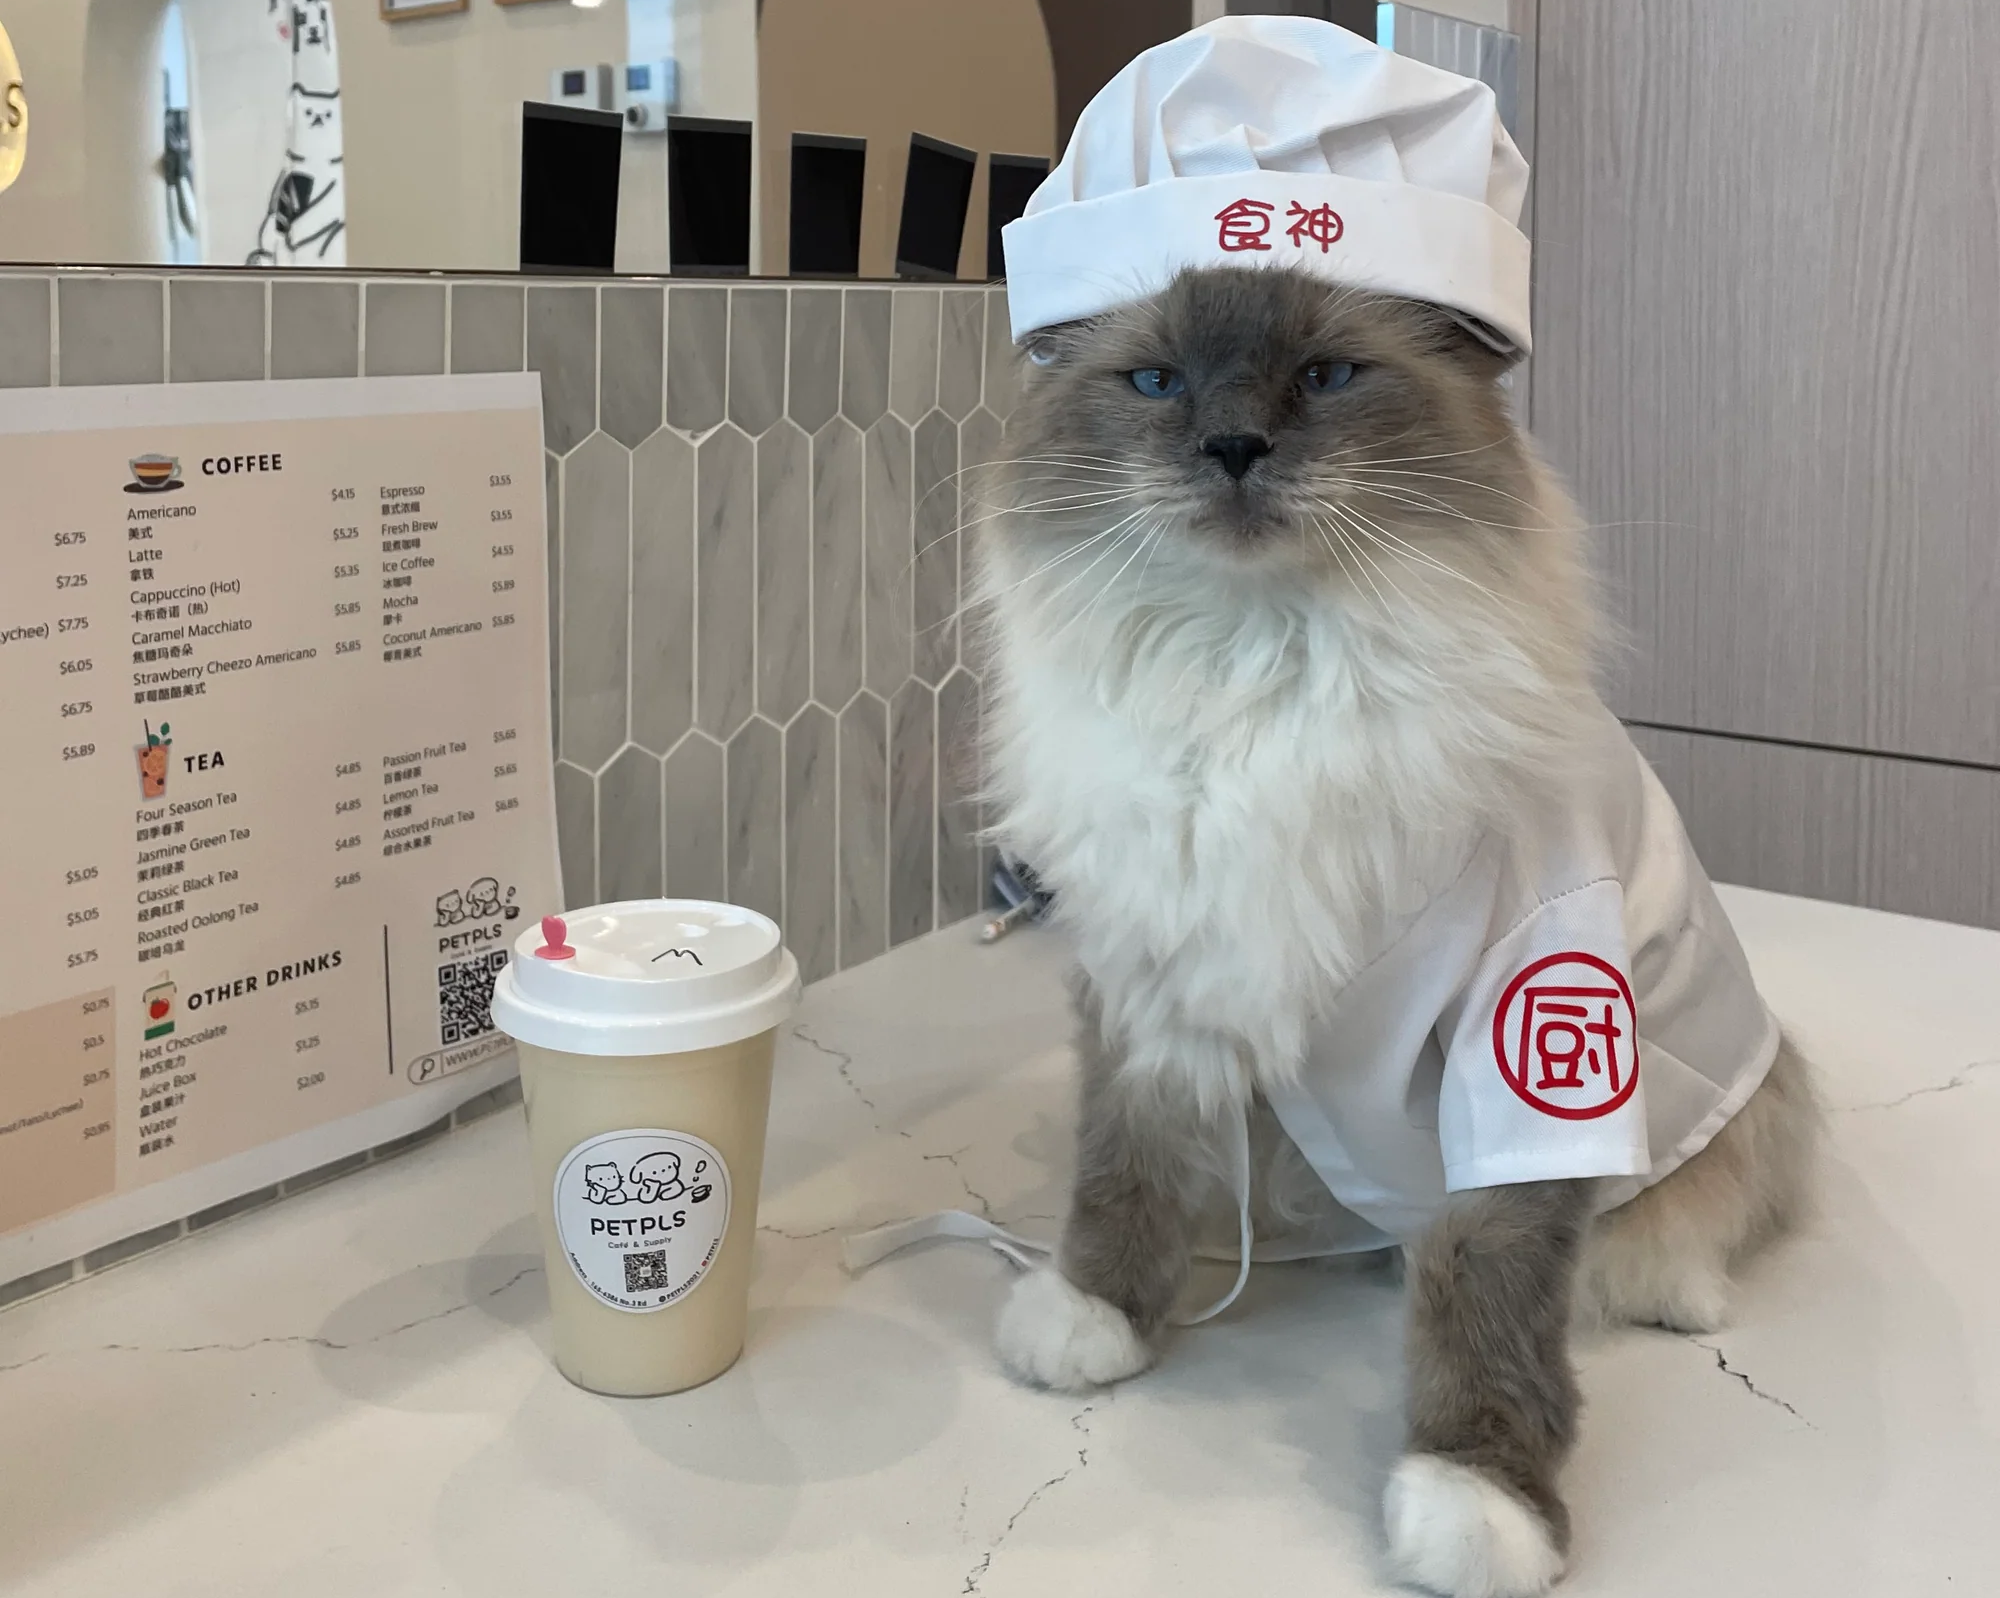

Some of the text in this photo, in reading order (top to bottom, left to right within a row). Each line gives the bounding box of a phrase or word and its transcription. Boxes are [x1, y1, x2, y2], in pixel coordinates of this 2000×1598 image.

[1214, 198, 1344, 253] 食神
[202, 454, 282, 475] COFFEE
[380, 475, 511, 500] Espresso $3.55
[127, 504, 196, 520] Americano
[381, 509, 512, 536] Fresh Brew $3.55
[54, 531, 86, 546] $6.75
[128, 526, 153, 540] 美式
[129, 549, 163, 563] Latte
[382, 560, 398, 572] Ice
[400, 556, 435, 571] Coffee
[56, 574, 88, 589] $7.25
[130, 568, 154, 582] 拿铁
[130, 583, 206, 605] Cappuccino
[210, 579, 241, 597] (Hot)
[383, 595, 419, 609] Mocha
[58, 617, 89, 632] $7.75
[132, 626, 184, 645] Caramel
[188, 618, 252, 637] Macchiato
[383, 629, 426, 645] Coconut
[430, 621, 482, 637] Americano
[133, 644, 193, 664] 焦糖玛奇朵
[60, 659, 93, 675] $6.05
[133, 666, 203, 686] Strawberry
[207, 657, 252, 675] Cheezo
[255, 647, 317, 667] Americano
[61, 702, 92, 718] $6.75
[62, 744, 95, 761] $5.89
[184, 751, 224, 773] TEA
[383, 752, 421, 768] Passion
[423, 744, 446, 759] Fruit
[449, 742, 466, 753] Tea
[383, 788, 418, 805] Lemon
[421, 783, 439, 795] Tea
[136, 807, 165, 823] Four
[169, 798, 213, 816] Season
[217, 792, 237, 805] Tea
[383, 819, 429, 840] Assorted
[431, 814, 454, 829] Fruit
[458, 810, 475, 822] Tea
[137, 844, 186, 864] Jasmine
[190, 833, 226, 851] Green
[230, 828, 250, 841] Tea
[66, 866, 98, 884] $5.05
[137, 884, 180, 905] Classic
[183, 874, 215, 892] Black
[218, 869, 239, 883] Tea
[67, 908, 99, 926] $5.05
[138, 919, 188, 944] Roasted
[192, 908, 236, 929] Oolong
[238, 902, 259, 916] Tea
[439, 924, 502, 953] PETPLS
[188, 950, 342, 1010] OTHER DRINKS
[140, 1046, 162, 1061] Hot
[166, 1025, 227, 1053] Chocolate
[140, 1081, 170, 1101] Juice
[173, 1072, 196, 1087] Box
[139, 1116, 177, 1138] Water
[591, 1210, 686, 1236] PETPLS
[644, 1237, 672, 1247] Supply
